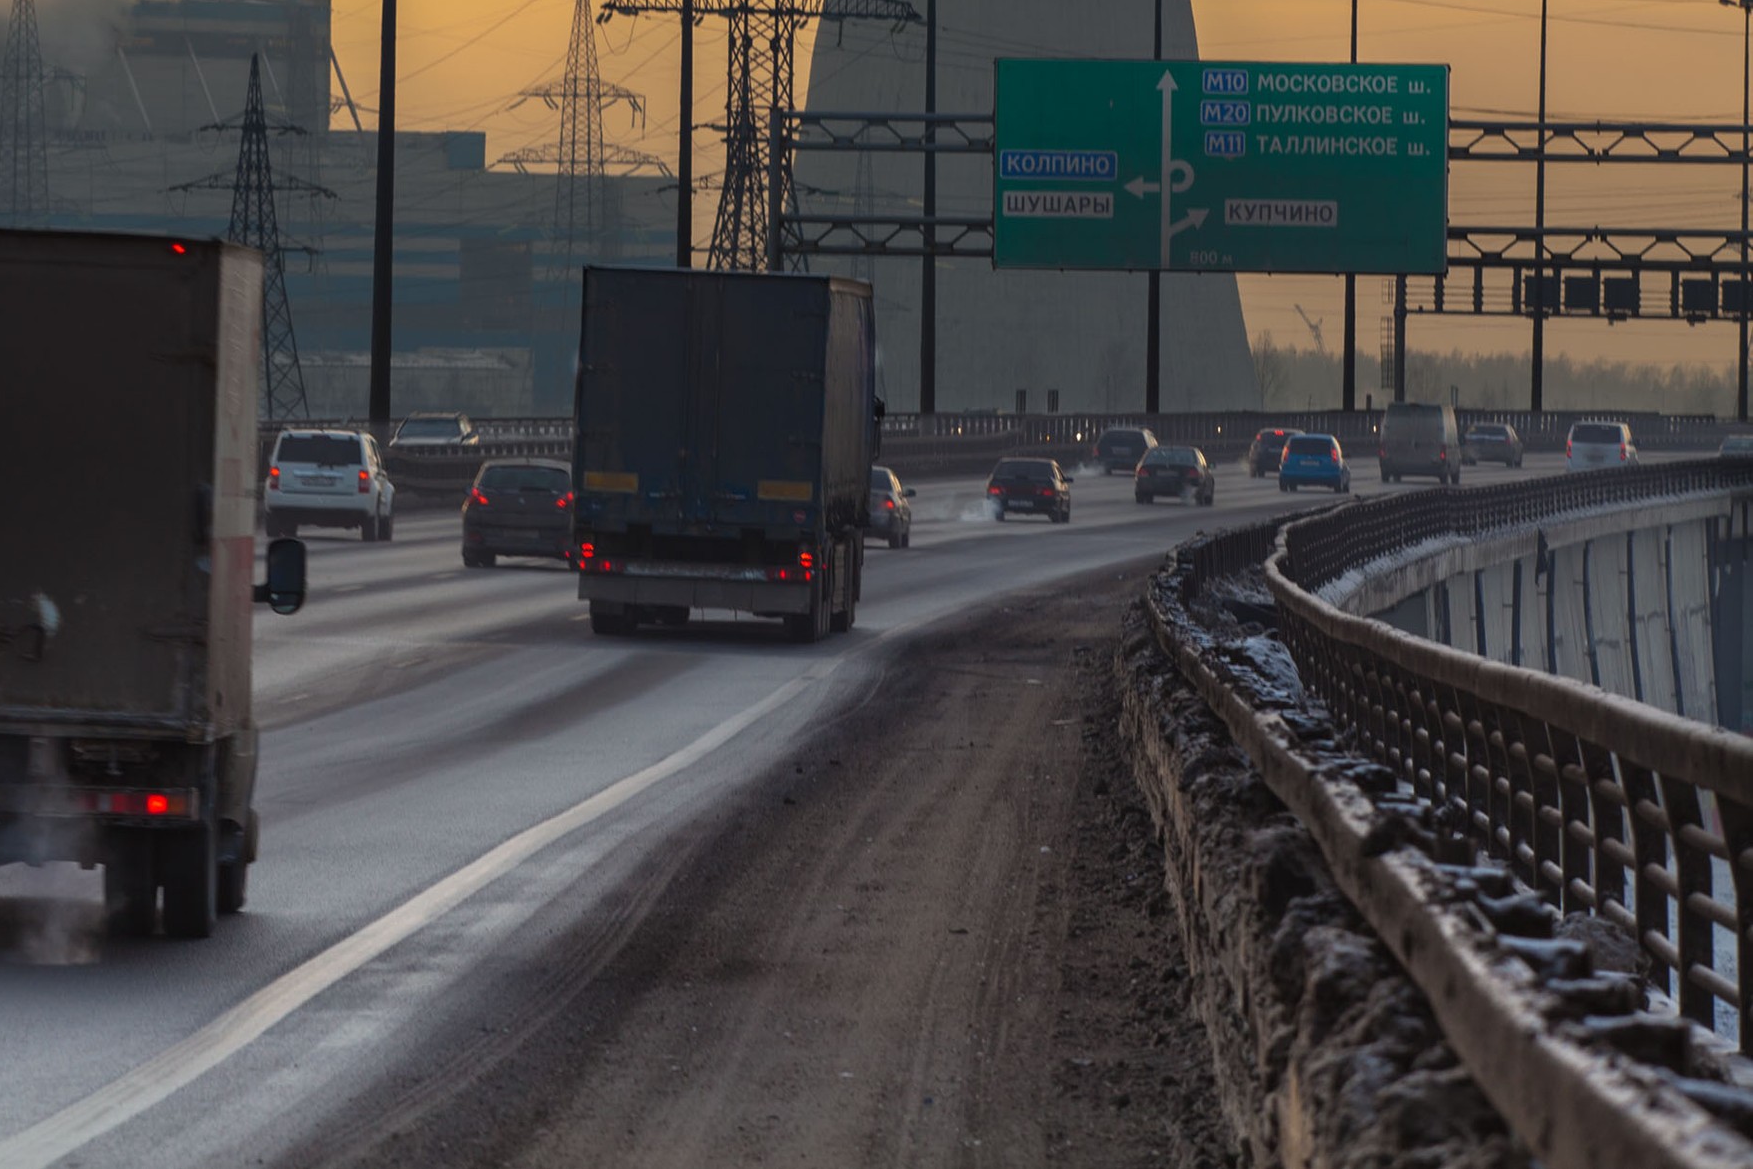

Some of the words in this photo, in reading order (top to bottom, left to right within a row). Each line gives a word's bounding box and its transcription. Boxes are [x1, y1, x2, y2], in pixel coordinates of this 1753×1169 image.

[1257, 73, 1398, 94] МОСКОВСКОЕ
[1408, 80, 1431, 94] ш.
[1256, 103, 1393, 124] ПУЛКОВСКОЕ
[1403, 111, 1426, 125] ш.
[1256, 135, 1398, 156] ТАЛЛИНСКОЕ
[1407, 142, 1430, 156] ш.
[1007, 154, 1110, 175] КОЛПИНО
[1007, 195, 1110, 213] ШУШАРЫ
[1229, 203, 1333, 223] КУПЧИНО
[1190, 250, 1218, 265] 800
